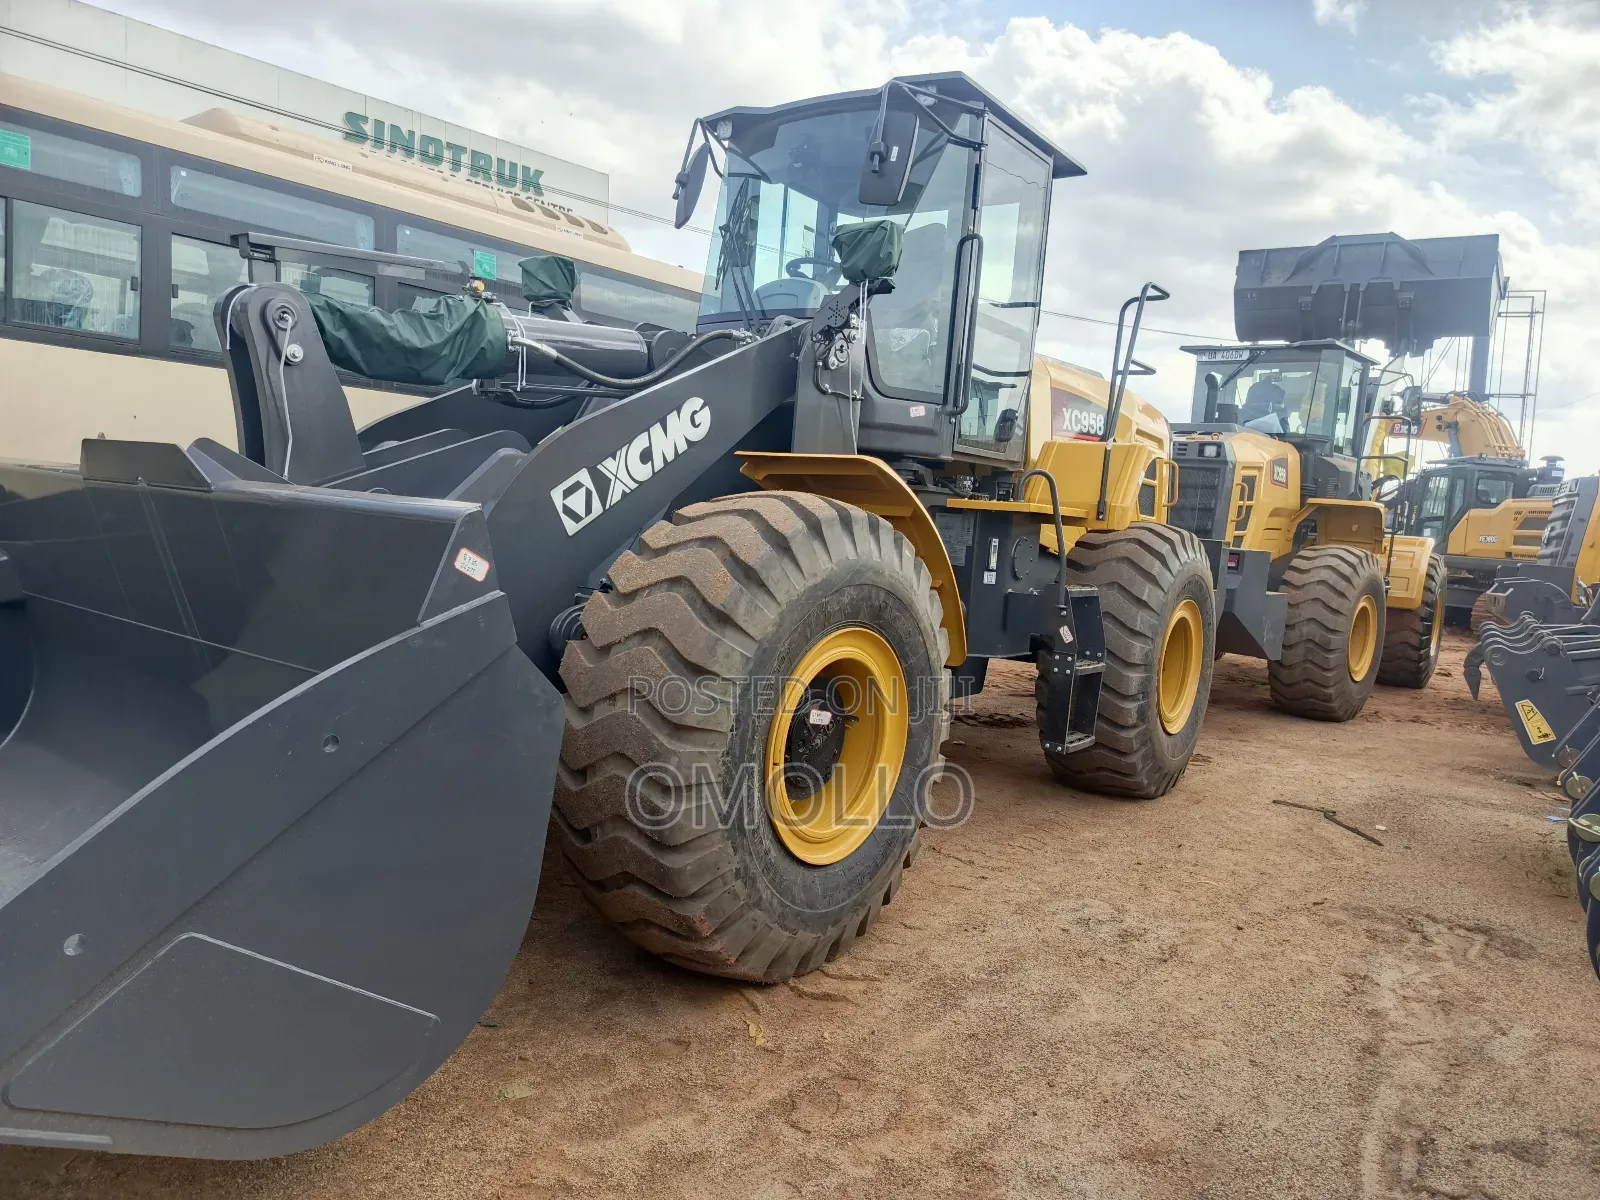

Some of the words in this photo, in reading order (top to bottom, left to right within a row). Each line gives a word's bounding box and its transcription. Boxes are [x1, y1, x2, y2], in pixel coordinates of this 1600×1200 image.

[342, 110, 545, 197] SINOTRUK
[597, 396, 711, 511] XCMG
[1062, 407, 1105, 436] XC958
